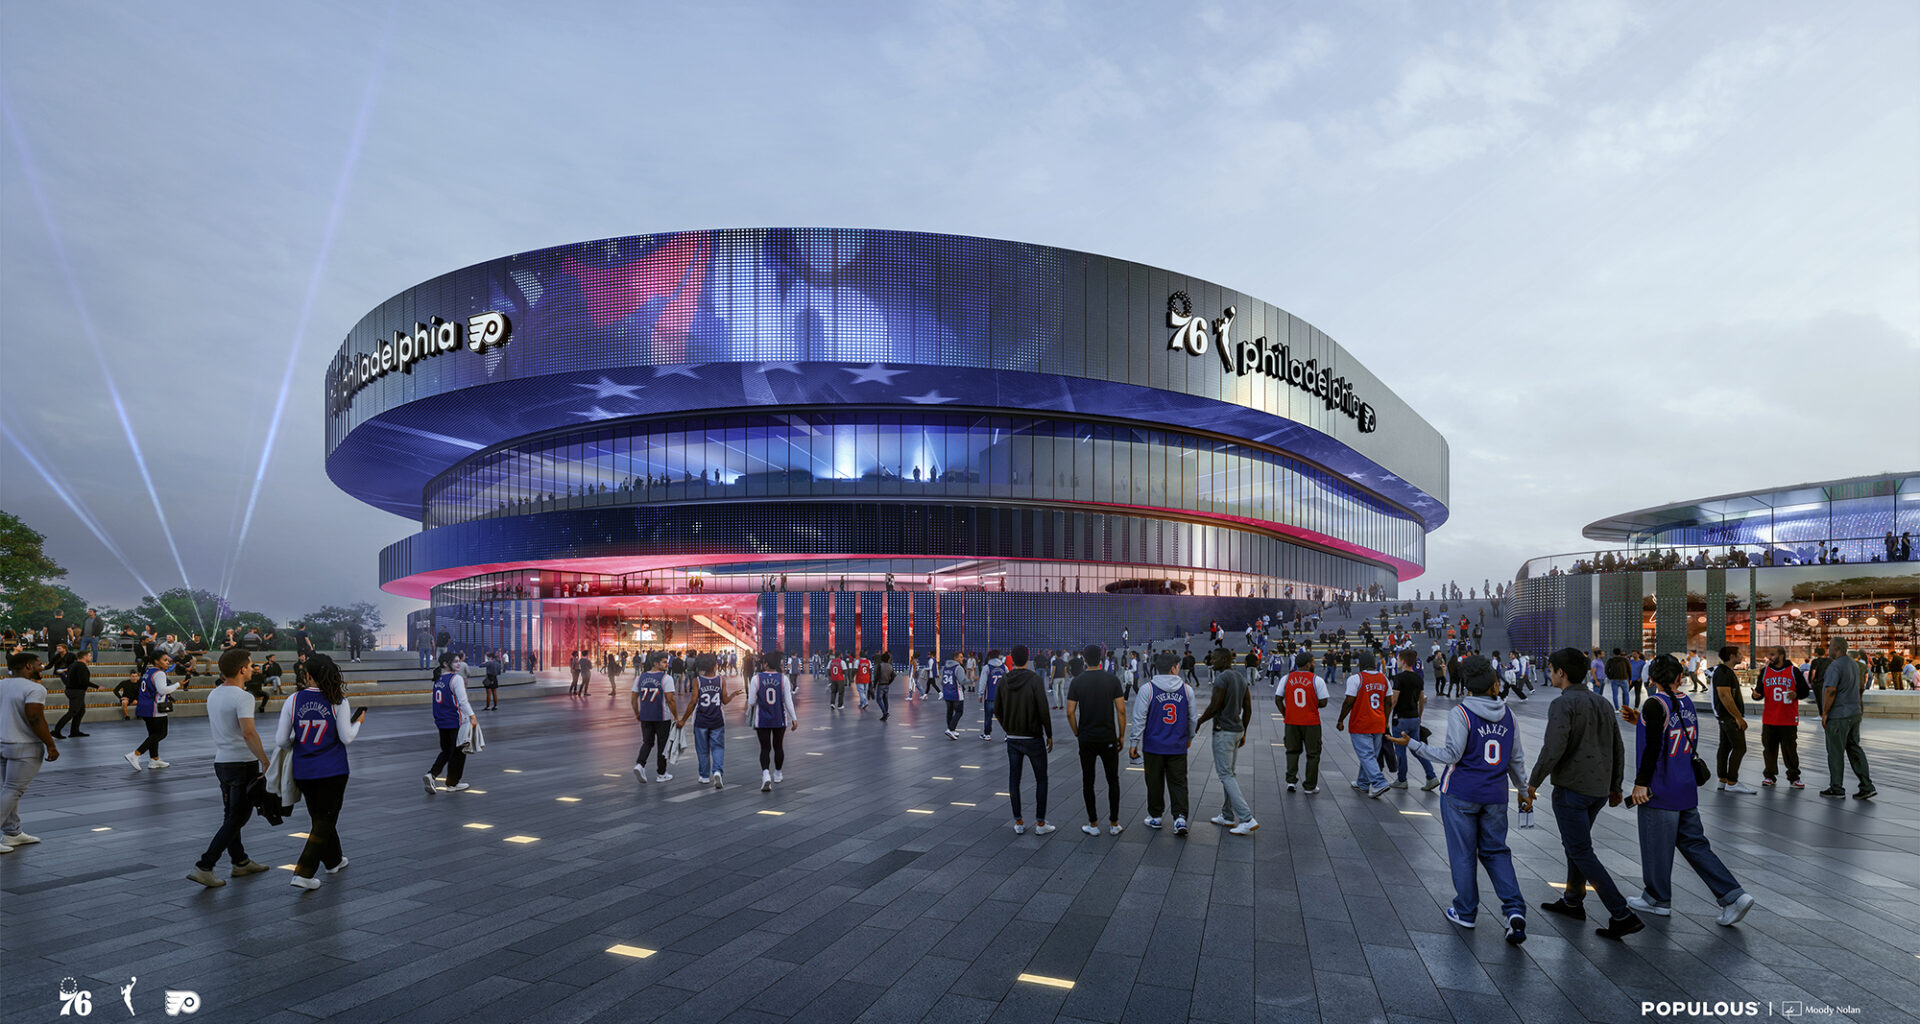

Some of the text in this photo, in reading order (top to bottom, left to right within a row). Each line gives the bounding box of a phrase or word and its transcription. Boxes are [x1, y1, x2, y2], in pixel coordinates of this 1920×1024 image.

[1170, 312, 1210, 355] 76
[340, 315, 456, 402] hiladelphia
[1238, 337, 1361, 419] philadelphia
[141, 680, 147, 692] 0
[943, 674, 953, 685] 34
[1289, 676, 1312, 687] MAXEY
[1766, 677, 1792, 688] SIXERS
[436, 689, 443, 704] 0
[641, 688, 659, 703] 77
[700, 693, 720, 707] 34
[766, 687, 776, 705] 0
[1156, 693, 1183, 703] IVERSON
[1294, 688, 1306, 708] 0
[1370, 693, 1380, 709] 6
[297, 702, 331, 719] EDGECOMBE
[1163, 703, 1177, 724] 3
[1669, 709, 1697, 728] EDGCOMBE
[298, 719, 329, 746] 77
[1477, 724, 1508, 738] MAXEY
[1669, 726, 1696, 757] 77
[1484, 739, 1501, 766] 0
